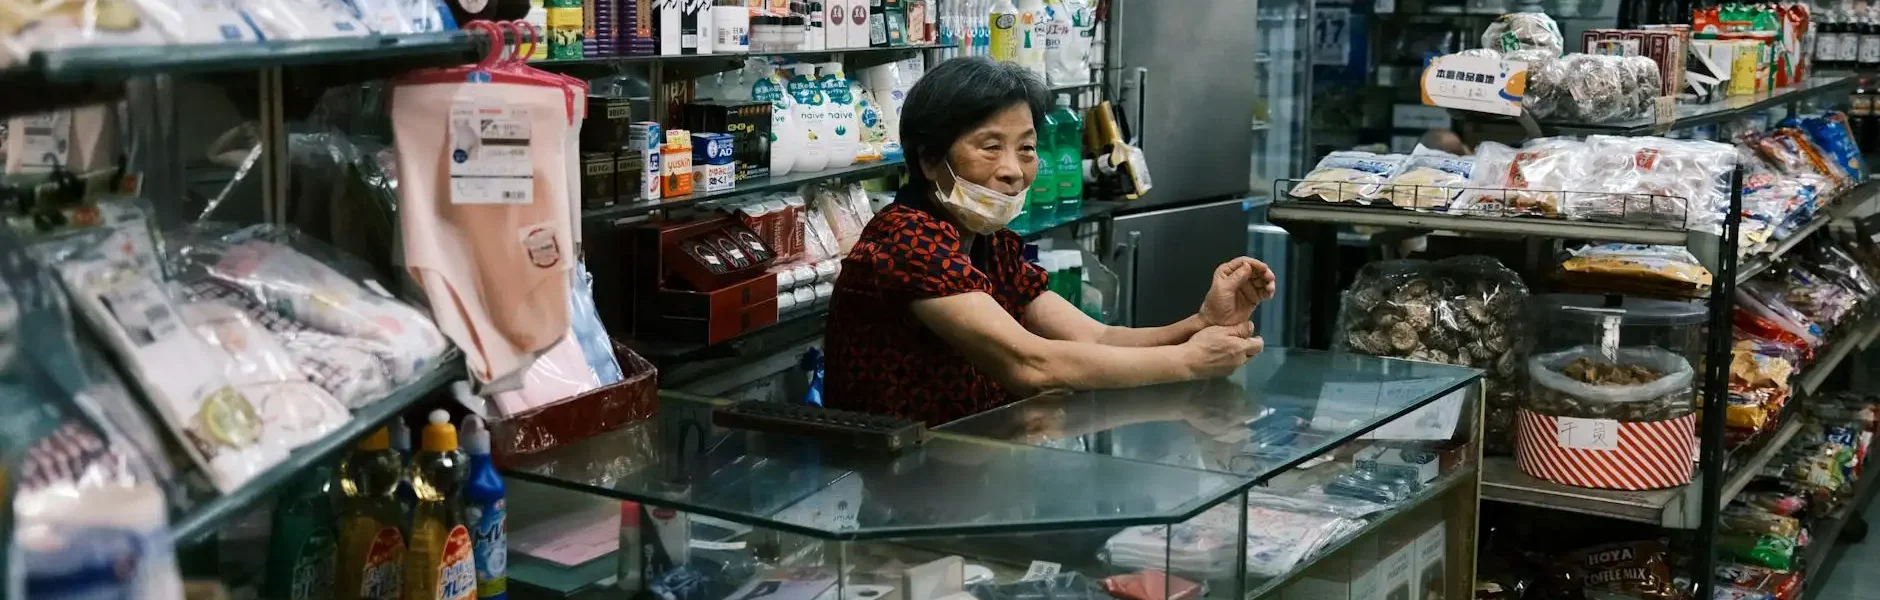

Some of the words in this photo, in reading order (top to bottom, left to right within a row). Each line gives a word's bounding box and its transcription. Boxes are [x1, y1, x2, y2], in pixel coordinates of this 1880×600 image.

[1046, 24, 1069, 35] リエール
[1316, 19, 1345, 44] 17
[1045, 38, 1061, 47] BIO
[719, 148, 733, 158] AD
[667, 156, 691, 172] yuskin
[1588, 548, 1633, 566] HOYA
[1623, 567, 1647, 580] MIX
